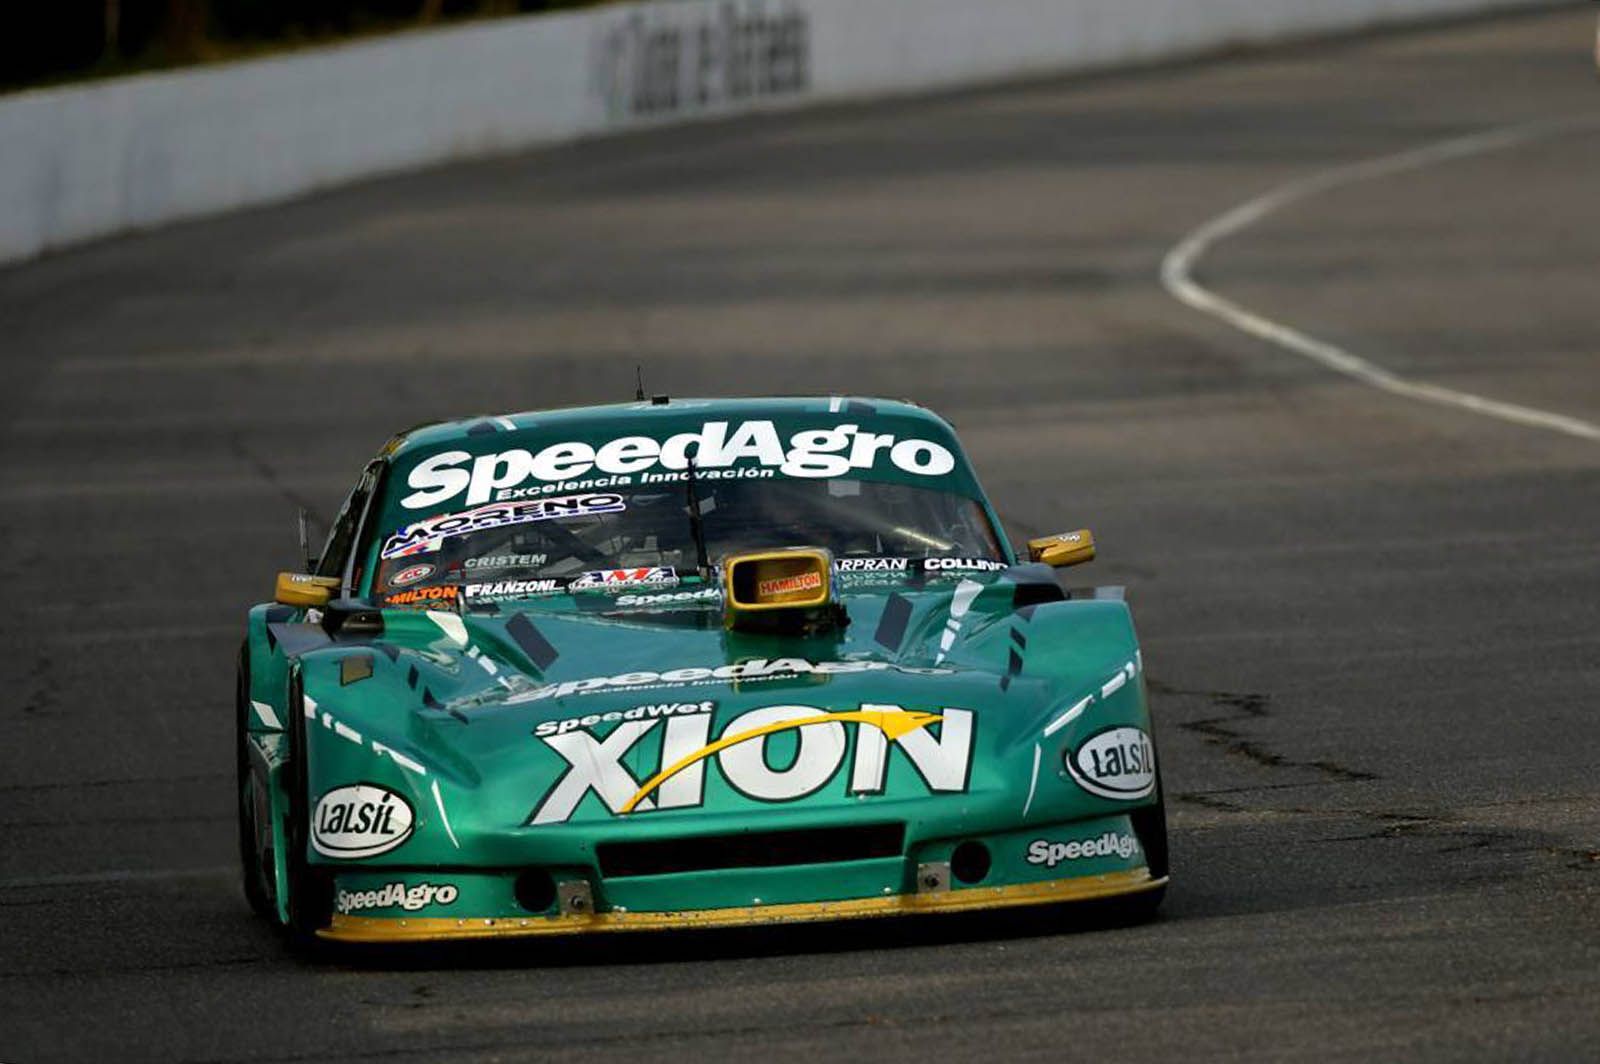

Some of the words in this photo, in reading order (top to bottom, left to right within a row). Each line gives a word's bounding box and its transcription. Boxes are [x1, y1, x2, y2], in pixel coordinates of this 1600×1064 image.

[401, 420, 956, 509] SpeedAgro
[496, 475, 632, 501] Excelencia
[385, 494, 624, 550] MORENO
[464, 553, 548, 568] CRISTEM
[761, 573, 820, 594] HAMILTON
[534, 701, 713, 737] SpeedWet
[521, 703, 973, 827] XION
[336, 883, 458, 915] SpeedAgro
